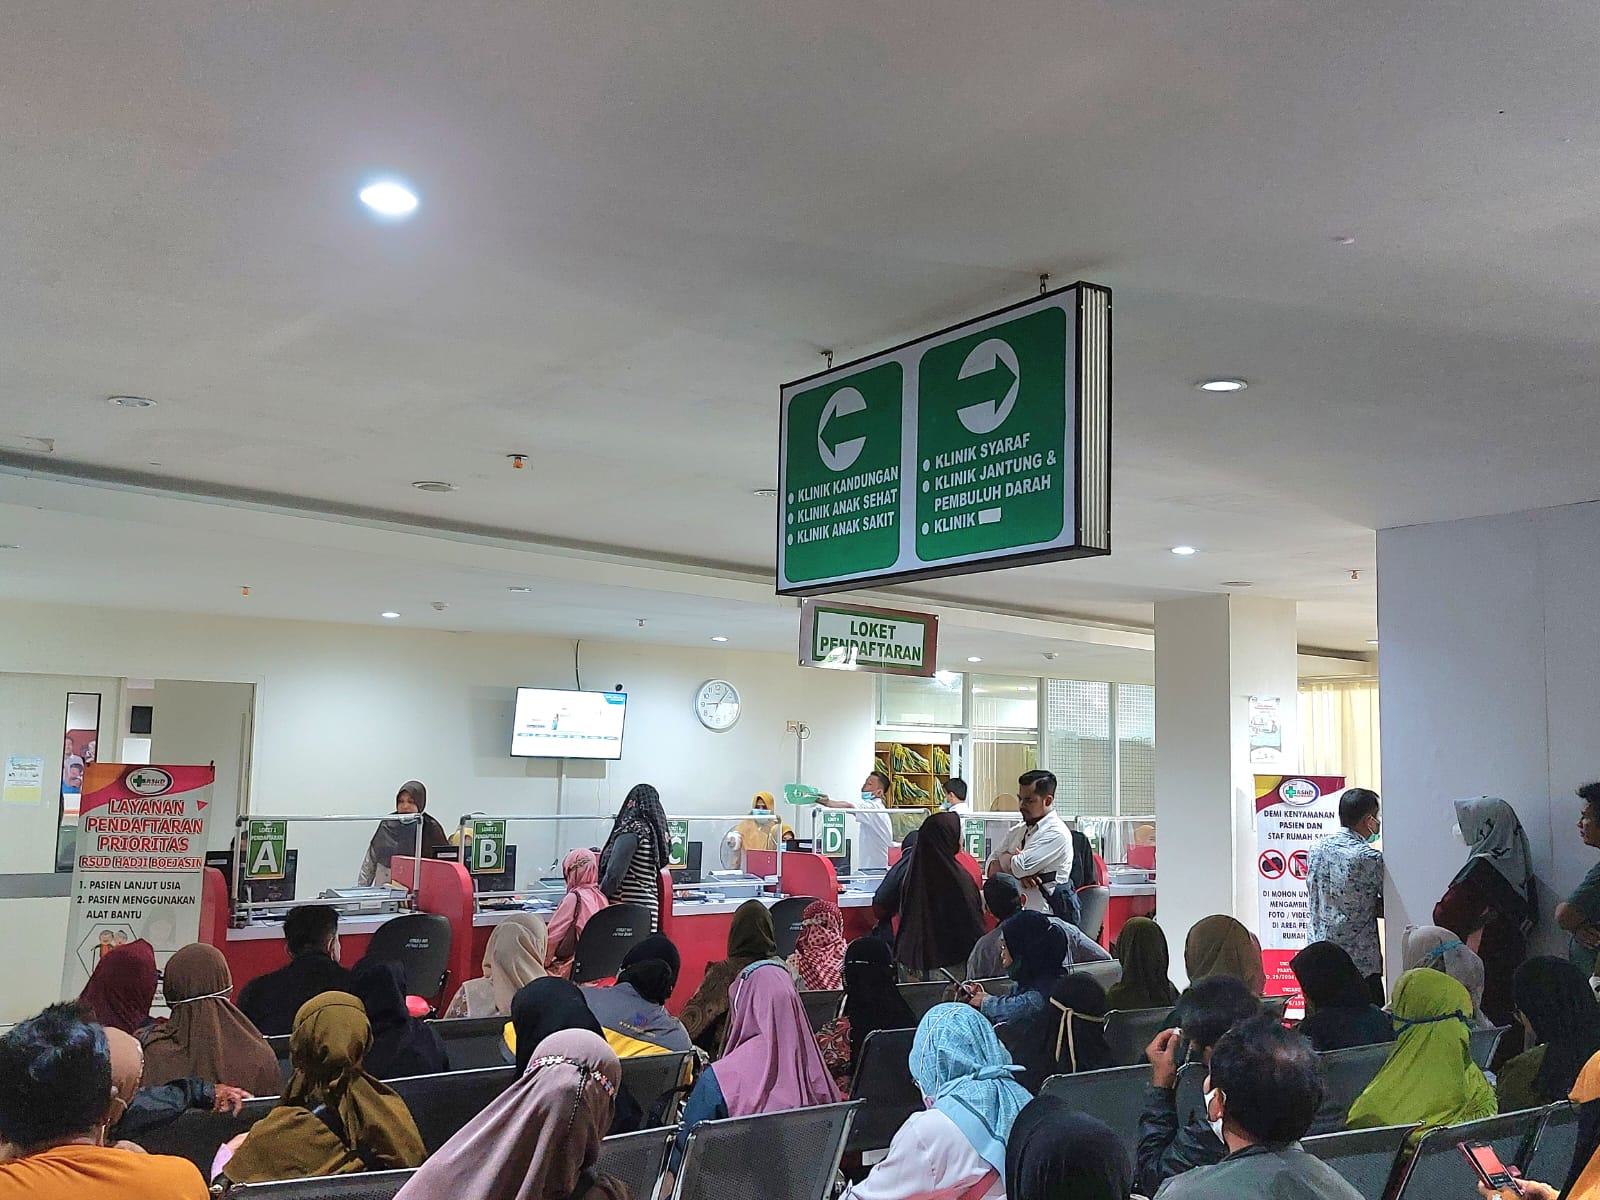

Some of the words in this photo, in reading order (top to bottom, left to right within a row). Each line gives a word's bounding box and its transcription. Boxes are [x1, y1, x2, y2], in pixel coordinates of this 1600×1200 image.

[935, 445, 976, 469] KLINIK
[980, 432, 1030, 458] SYARAF
[935, 468, 976, 490] KLINIK
[979, 453, 1042, 480] JANTUNG
[1046, 450, 1056, 465] &
[798, 483, 830, 502] KLINIK
[833, 466, 899, 495] KANDUNGAN
[934, 485, 1001, 512] PEMBULUH
[1005, 474, 1051, 497] DARAH
[797, 504, 830, 523] KLINIK
[832, 497, 860, 516] ANAK
[863, 489, 898, 509] SEHAT
[797, 525, 829, 544] KLINIK
[831, 519, 860, 537] ANAK
[862, 512, 895, 531] SAKIT
[934, 512, 976, 533] KLINIK
[851, 620, 896, 640] LOKET
[109, 798, 184, 815] LAYANAN
[1284, 810, 1335, 818] KENYAMANAN
[85, 816, 203, 834] PENDAFTARAN
[1268, 832, 1284, 840] STAF
[97, 836, 190, 852] PRIORITAS
[668, 836, 683, 865] C
[826, 828, 842, 852] D
[970, 834, 980, 858] E
[79, 856, 111, 868] RSUD
[113, 856, 148, 868] HADJI
[149, 856, 202, 869] BOEJASIN
[251, 840, 279, 873] A
[479, 839, 498, 868] B
[79, 881, 87, 889] 1.
[89, 881, 121, 889] PASIEN
[124, 881, 158, 890] LANJUT
[160, 881, 181, 890] USIA
[77, 896, 85, 904] 2.
[88, 896, 120, 904] PASIEN
[122, 896, 195, 905] MENGGUNAKAN
[86, 911, 108, 919] ALAT
[111, 911, 142, 919] BANTU
